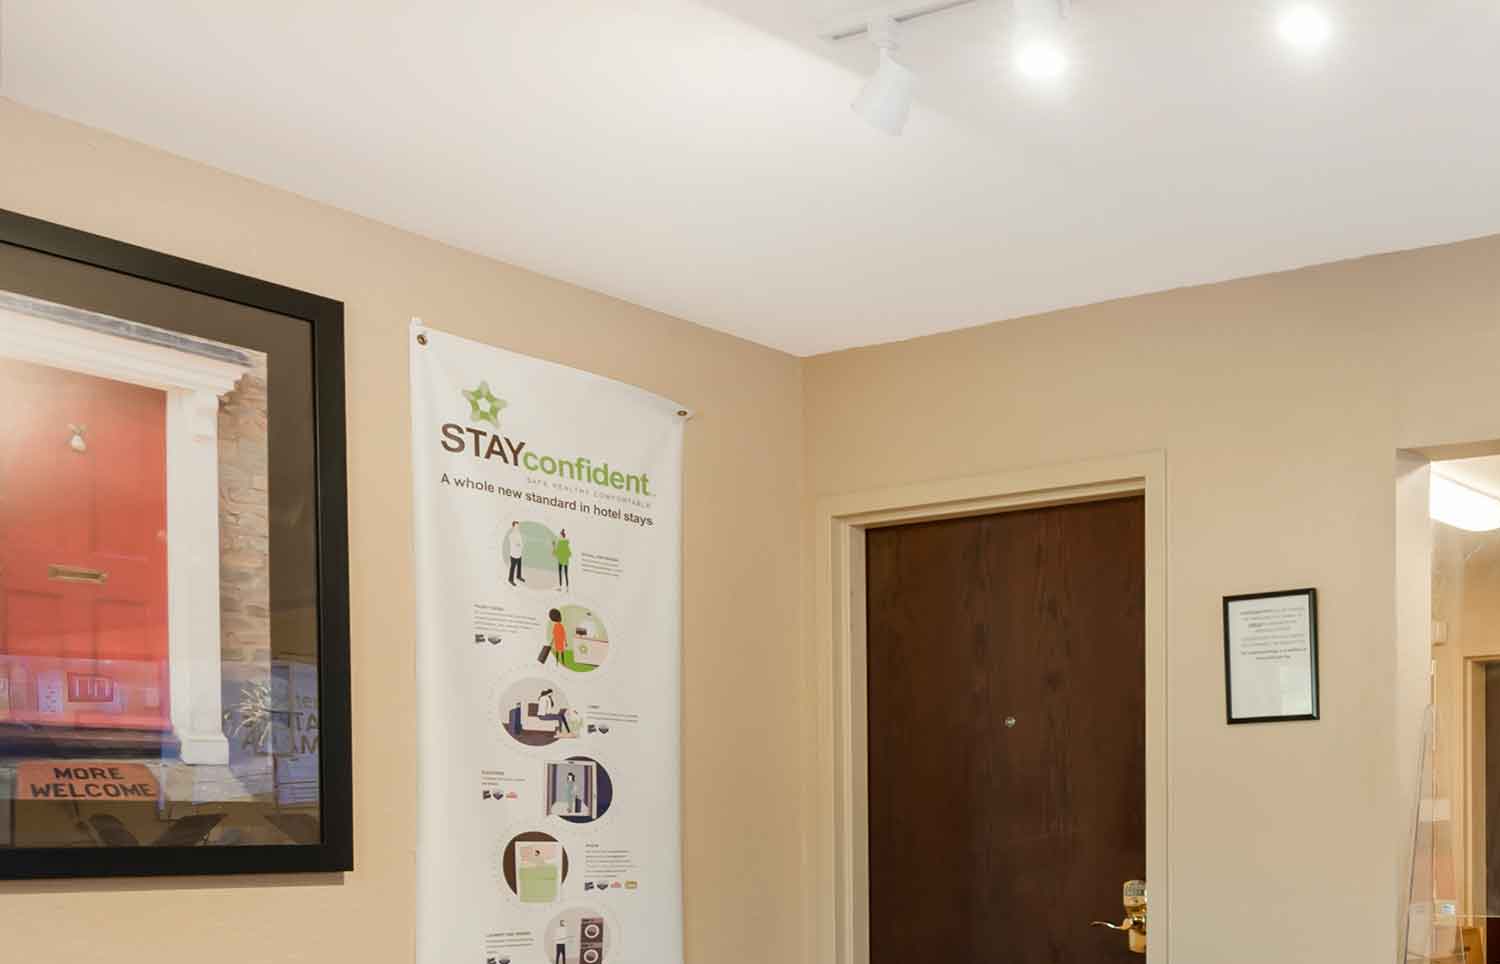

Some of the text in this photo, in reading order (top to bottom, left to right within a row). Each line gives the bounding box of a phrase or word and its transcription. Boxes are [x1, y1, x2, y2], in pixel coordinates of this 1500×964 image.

[440, 473, 654, 527] A whole new standard in hotel stays
[53, 767, 125, 780] MORE
[30, 783, 158, 798] WELCOME
